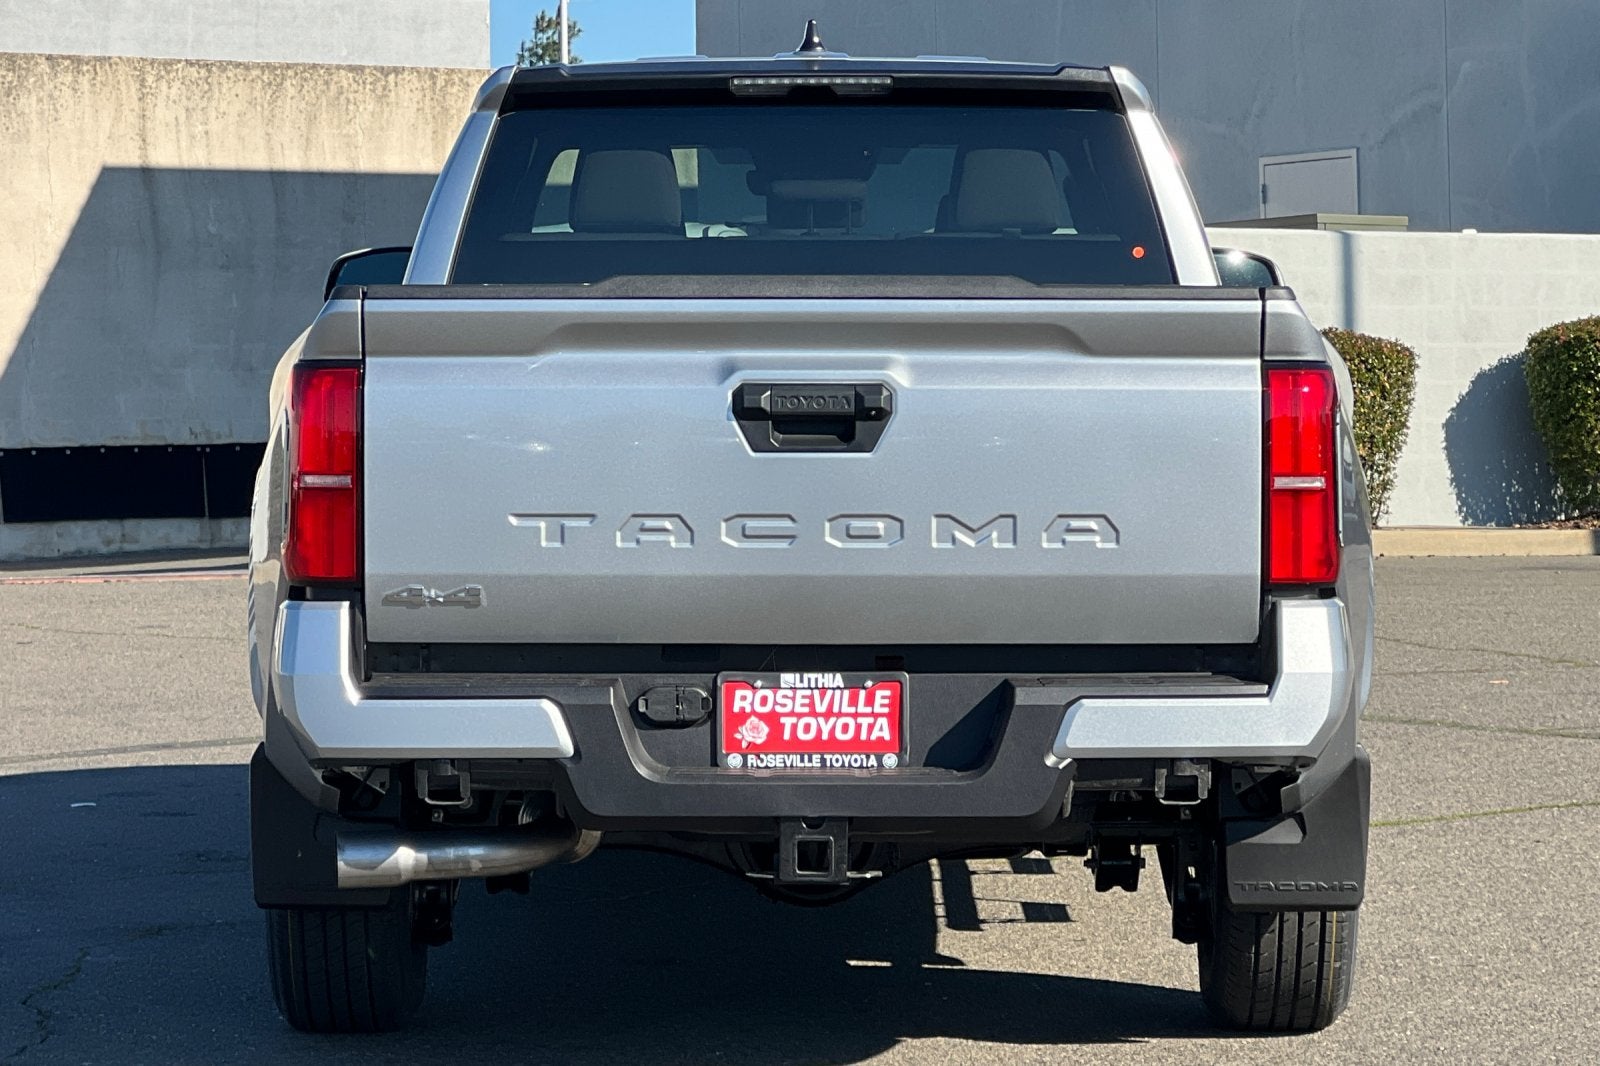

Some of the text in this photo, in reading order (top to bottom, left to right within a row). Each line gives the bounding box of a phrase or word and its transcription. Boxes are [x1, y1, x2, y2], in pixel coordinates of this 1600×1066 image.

[775, 395, 851, 409] TOYOTA
[508, 513, 1121, 549] TACOMA
[794, 673, 845, 688] LITHIA
[733, 689, 892, 714] ROSEVILLE
[779, 716, 891, 741] TOYOTA
[747, 754, 878, 768] ROSEVILLE TOYOTA
[1234, 880, 1359, 892] TACOMA
